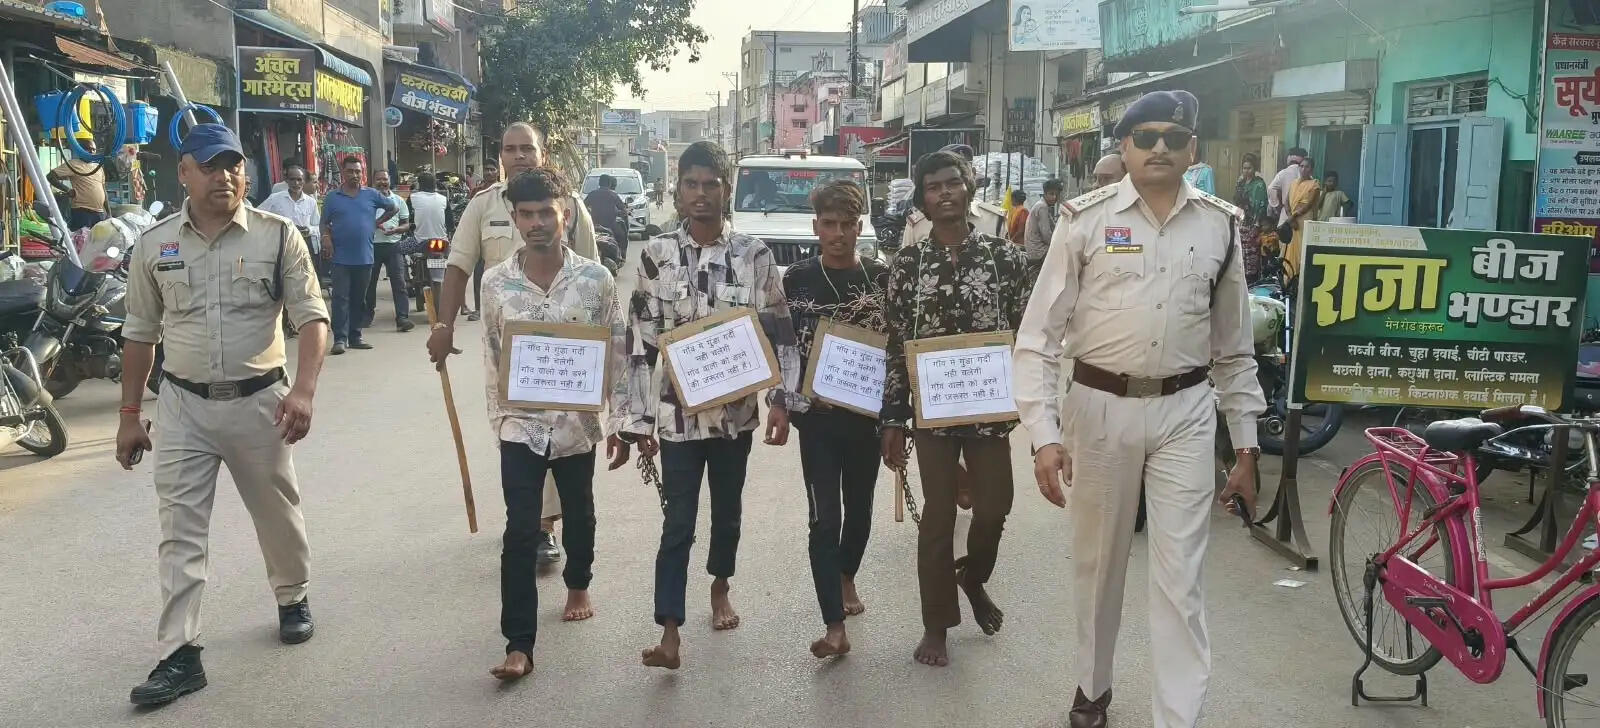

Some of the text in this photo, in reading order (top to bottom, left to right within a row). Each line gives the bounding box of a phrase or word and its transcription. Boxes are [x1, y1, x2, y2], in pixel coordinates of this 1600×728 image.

[255, 53, 300, 74] अंचल
[1555, 59, 1589, 70] प्रधानमंत्री
[401, 91, 459, 119] बीज भंडार
[1545, 129, 1587, 140] WAAREE
[1472, 238, 1564, 281] बीज
[1312, 253, 1447, 327] राजा
[1449, 292, 1577, 327] भण्डार
[1385, 318, 1399, 331] मेन
[1400, 319, 1417, 331] रोड
[1332, 362, 1363, 377] मछली
[1398, 367, 1430, 383] कछुआ
[1464, 368, 1506, 382] प्लास्टिक
[1510, 372, 1540, 384] गमला
